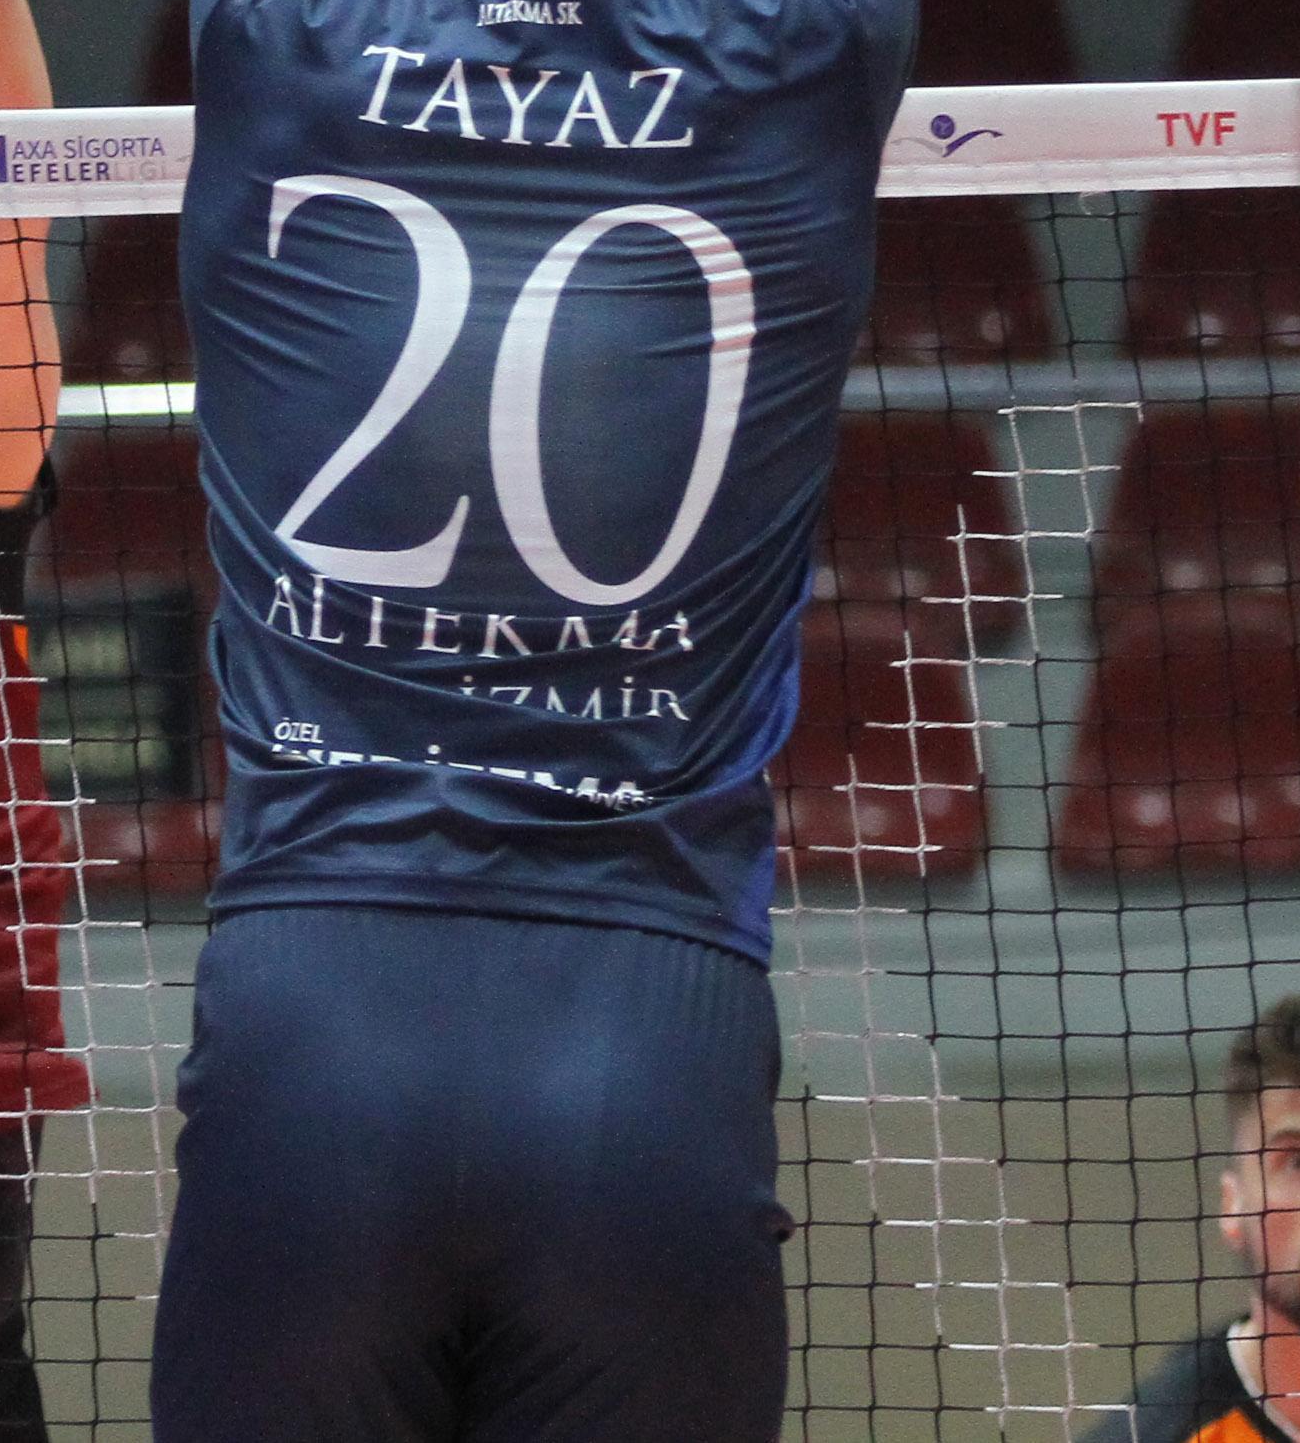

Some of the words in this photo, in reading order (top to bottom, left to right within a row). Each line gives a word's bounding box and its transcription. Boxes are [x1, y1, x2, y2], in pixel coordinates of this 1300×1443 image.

[557, 1, 583, 25] SK
[358, 44, 693, 149] TAYAZ
[1157, 111, 1237, 147] TVF
[12, 141, 58, 160] AXA
[63, 135, 166, 159] SİGORTA
[12, 161, 111, 183] EFELER
[266, 173, 758, 606] 20
